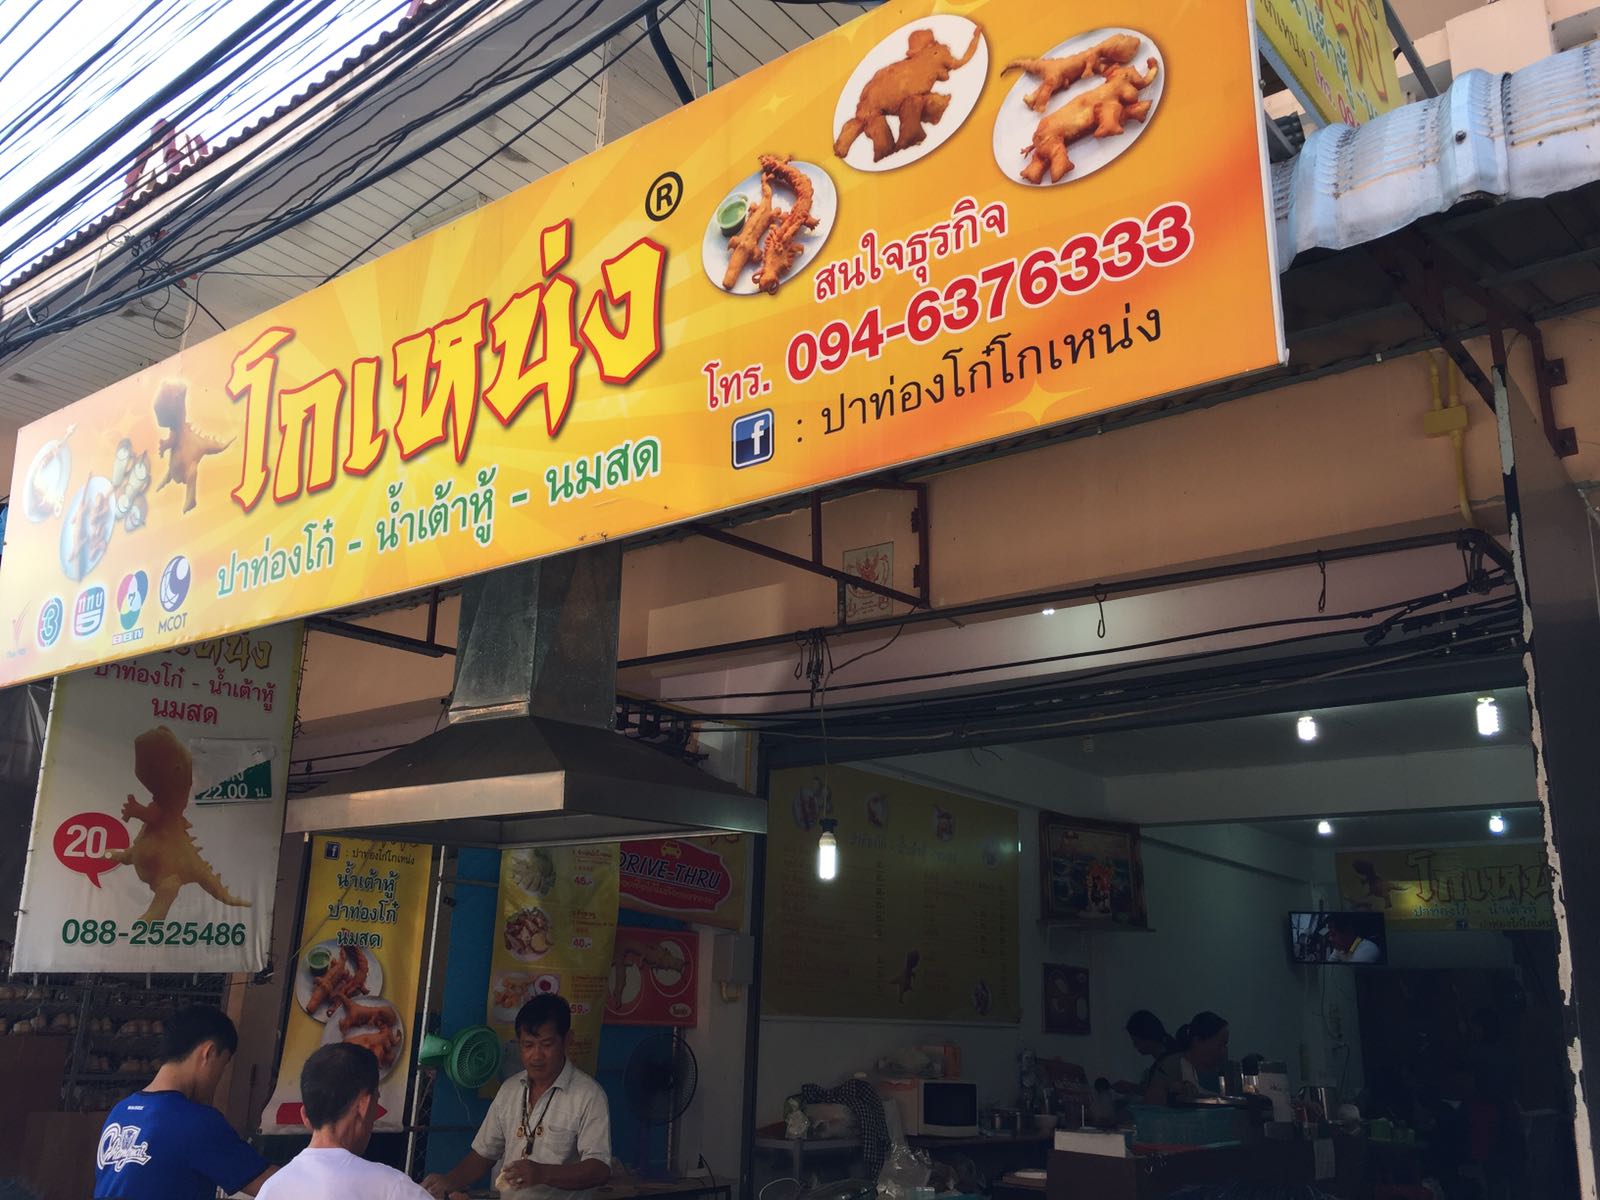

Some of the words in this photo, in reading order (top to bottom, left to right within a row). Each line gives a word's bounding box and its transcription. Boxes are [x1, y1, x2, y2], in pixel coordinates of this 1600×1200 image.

[815, 198, 1006, 300] สนใจธุรกิจ
[703, 362, 771, 409] โทร.
[786, 202, 1194, 382] 094-6376333
[226, 218, 665, 513] โกเหน่ง
[821, 303, 1162, 436] ปาท่องโก๋โกเหน่ง
[217, 518, 335, 596] ปาท่องโก๋
[376, 466, 498, 553] น้ำเต้าหู้
[545, 437, 660, 502] นมสด
[158, 613, 188, 634] MCOT
[209, 666, 276, 712] น้ำเต้าหู้
[151, 697, 219, 725] นมสด
[336, 860, 400, 900] น้ำเต้าหู้
[62, 918, 246, 947] 088-2525486
[327, 899, 400, 923] ปาท่องโก๋
[336, 929, 382, 949] นมสด
